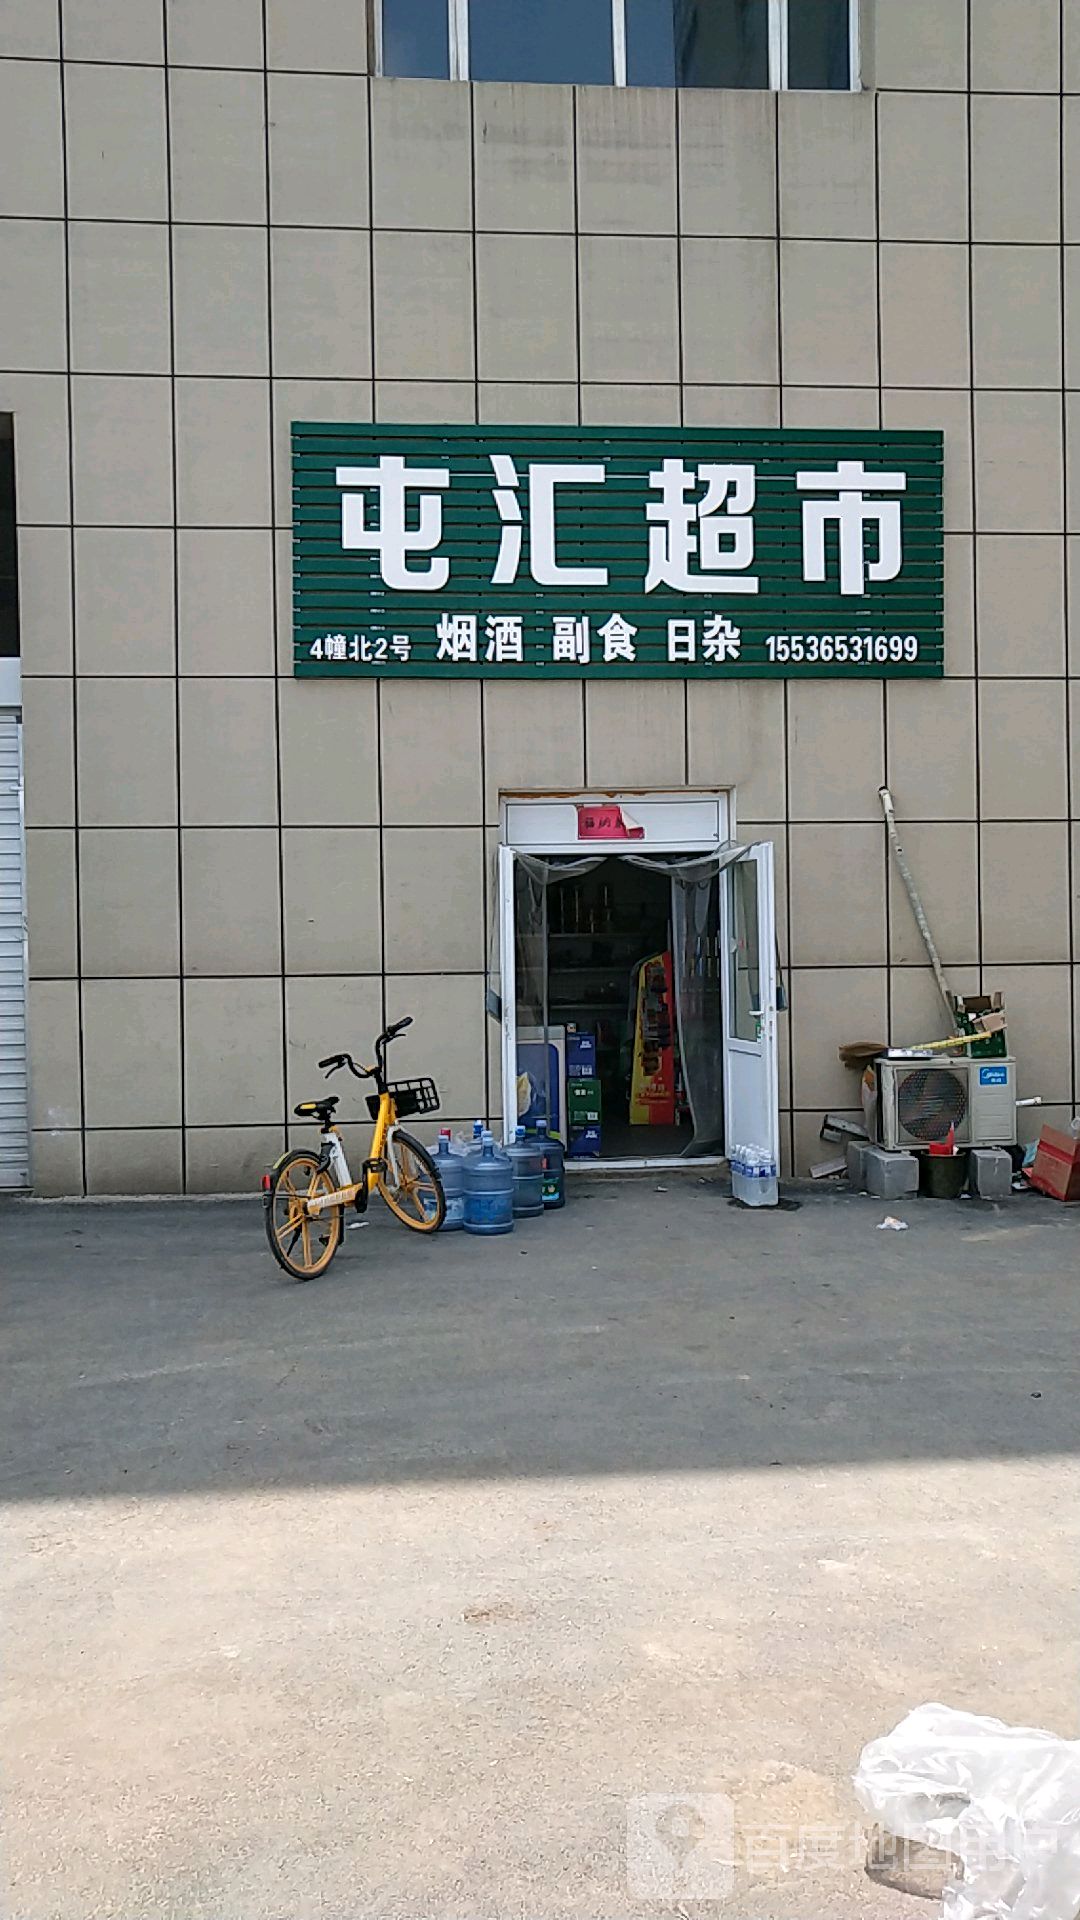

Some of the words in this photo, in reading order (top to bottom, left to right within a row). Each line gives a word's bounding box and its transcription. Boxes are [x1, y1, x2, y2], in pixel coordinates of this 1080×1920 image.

[335, 454, 907, 596] 屯汇超市
[309, 633, 412, 662] 4幢北2号
[436, 612, 524, 662] 烟酒
[552, 612, 638, 664] 副食
[667, 614, 741, 662] 日杂
[765, 635, 918, 662] 15536531699
